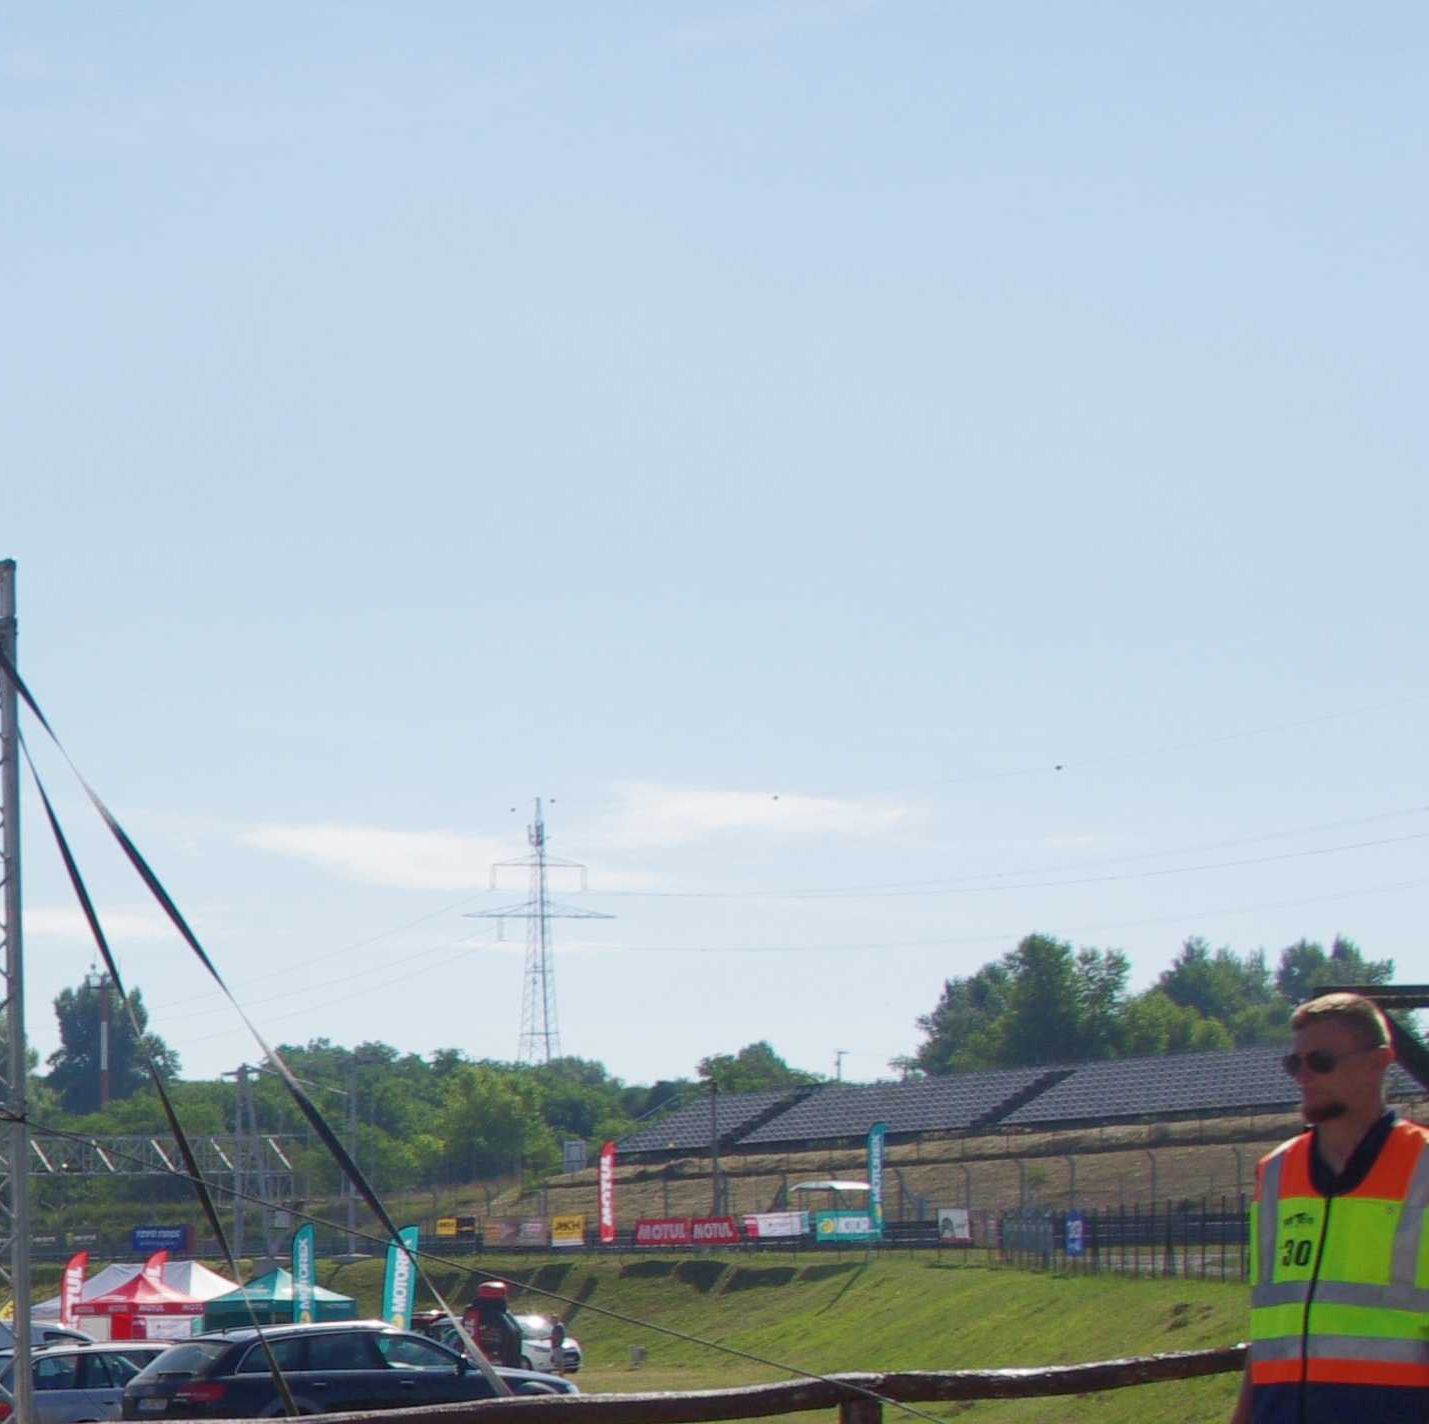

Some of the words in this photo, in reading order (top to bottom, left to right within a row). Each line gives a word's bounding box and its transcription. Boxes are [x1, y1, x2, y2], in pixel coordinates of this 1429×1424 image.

[601, 1154, 612, 1227] MOTUL
[639, 1223, 687, 1240] MOTUL
[693, 1221, 731, 1238] MOTUL
[1282, 1239, 1312, 1267] 30
